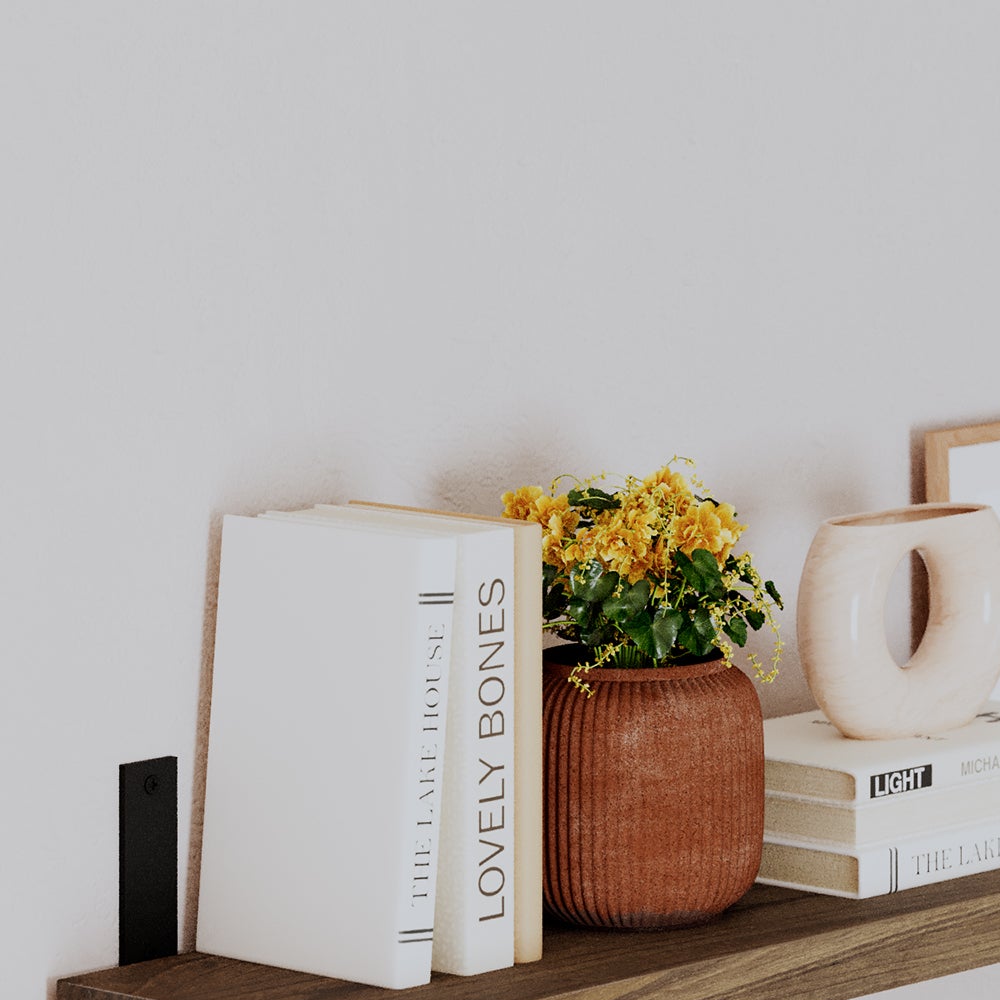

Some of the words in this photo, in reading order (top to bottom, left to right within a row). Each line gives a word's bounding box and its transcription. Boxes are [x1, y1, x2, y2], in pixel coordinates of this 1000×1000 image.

[422, 623, 446, 732] HOUSE
[478, 578, 506, 740] BONES
[417, 743, 437, 826] LAKE
[873, 766, 926, 798] LIGHT
[411, 838, 432, 907] THE
[478, 758, 505, 922] LOVELY
[911, 847, 952, 876] THE
